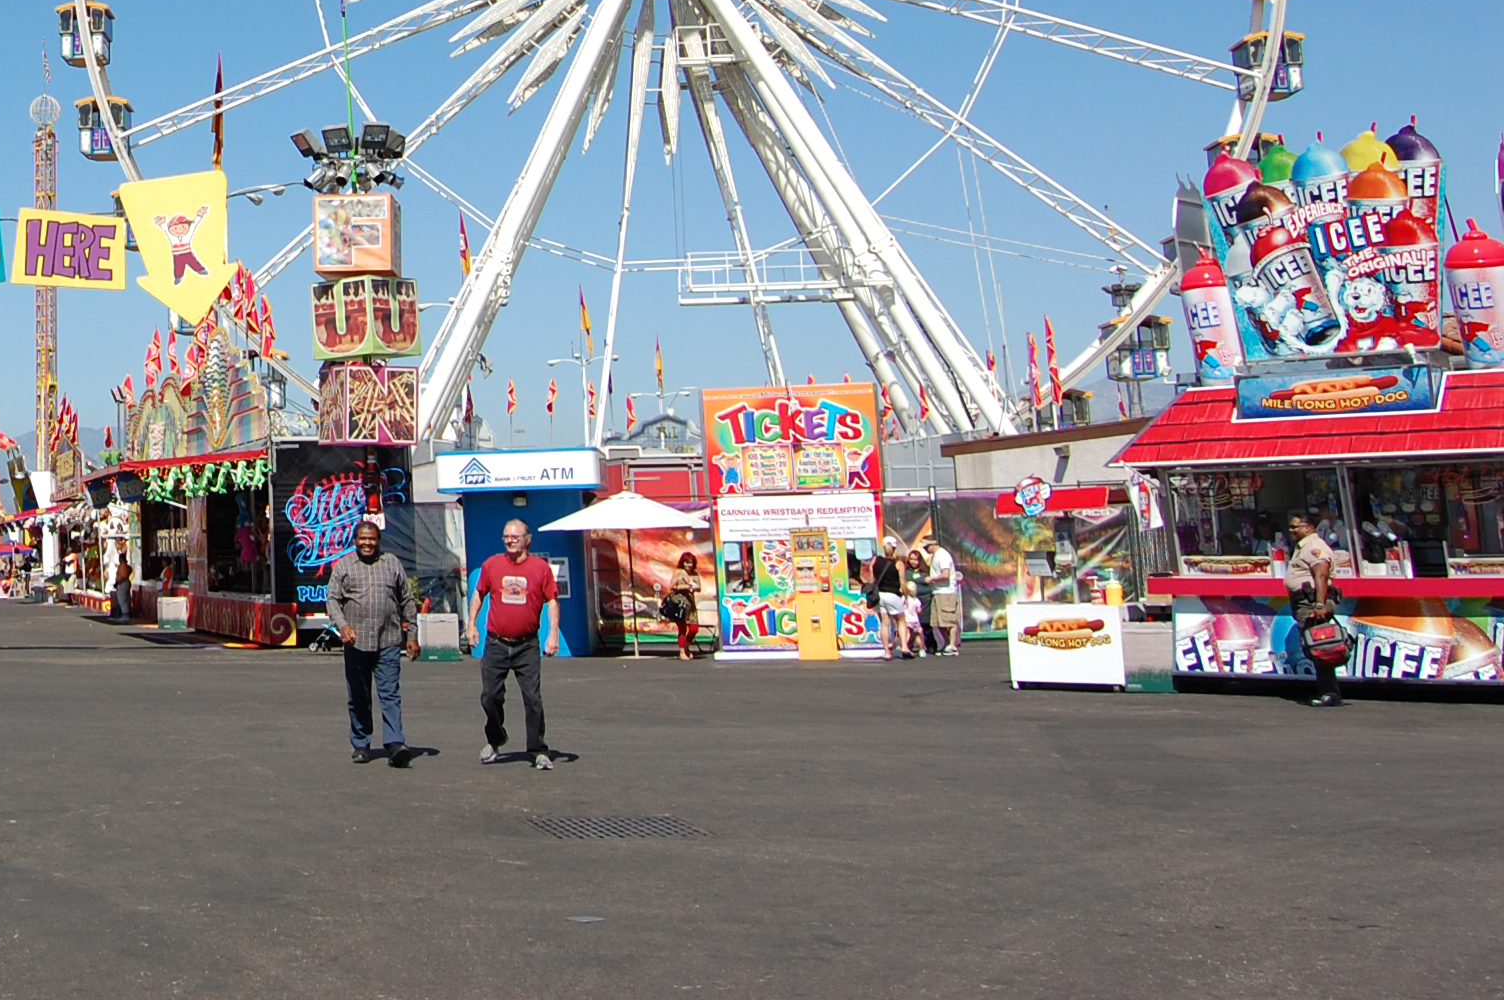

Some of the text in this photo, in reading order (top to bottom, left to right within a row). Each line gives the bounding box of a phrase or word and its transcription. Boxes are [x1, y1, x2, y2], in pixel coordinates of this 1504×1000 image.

[1286, 202, 1345, 239] EXPERIENCE
[1313, 213, 1385, 255] ICEE
[25, 218, 116, 282] HERE
[1341, 246, 1377, 268] THE
[1346, 249, 1427, 280] ORIGINAL!
[1261, 390, 1409, 410] MILE LONG HOT DOG
[716, 399, 863, 445] TICKETS
[465, 474, 486, 484] PFF
[540, 467, 574, 481] ATM
[816, 506, 873, 515] REDEMPTION
[297, 585, 329, 602] PLA
[1040, 637, 1066, 647] LONG
[1067, 637, 1088, 648] HOT
[1355, 632, 1444, 679] ICEE
